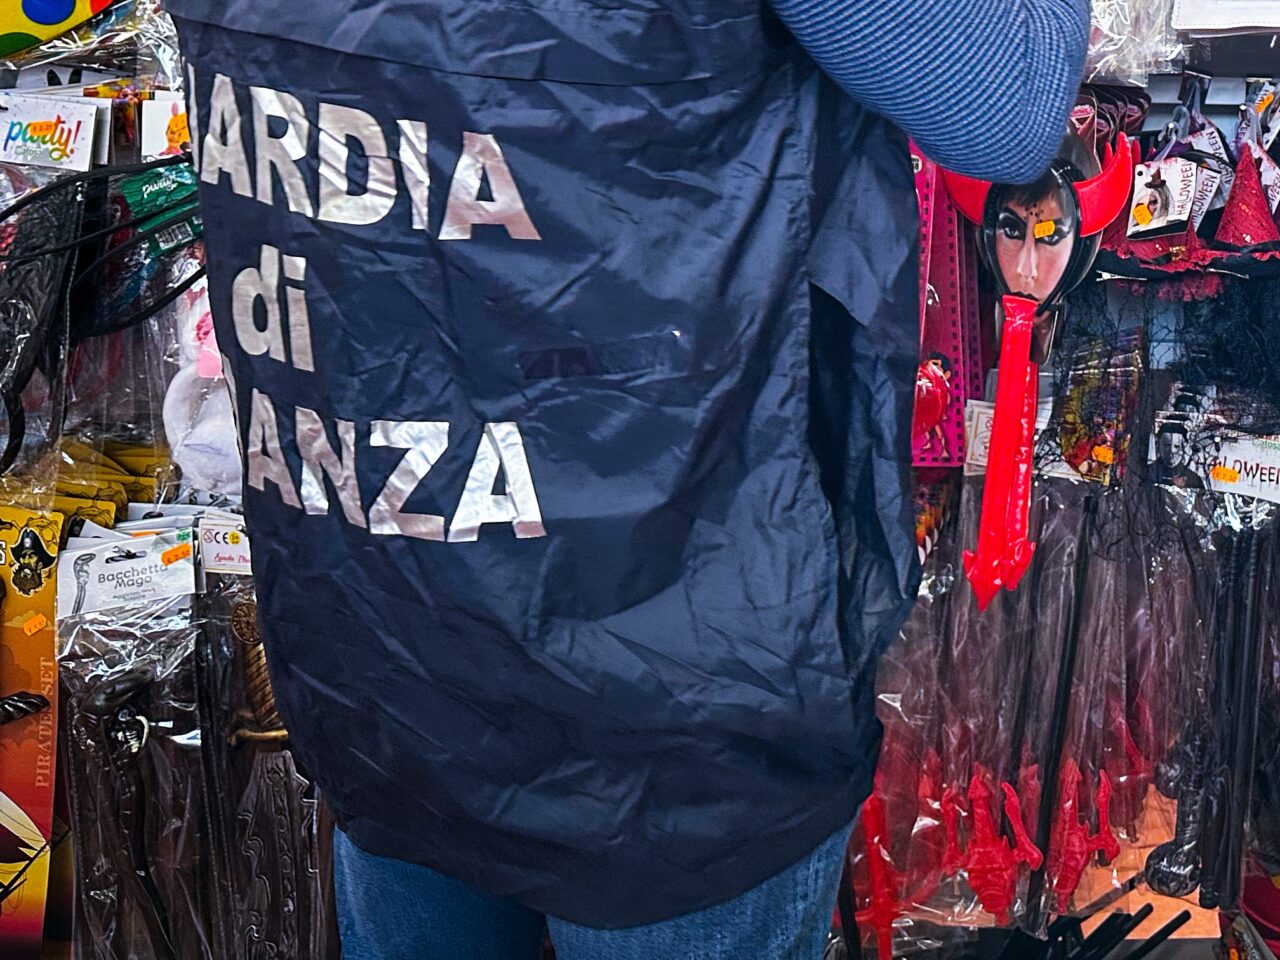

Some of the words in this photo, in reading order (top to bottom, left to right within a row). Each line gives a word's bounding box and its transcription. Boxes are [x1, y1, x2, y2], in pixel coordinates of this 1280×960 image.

[231, 243, 315, 372] di
[247, 387, 548, 543] ANZA
[98, 565, 168, 584] Bacchetta
[114, 575, 153, 590] Mago
[40, 656, 54, 696] SET
[35, 712, 52, 790] PIRATE
